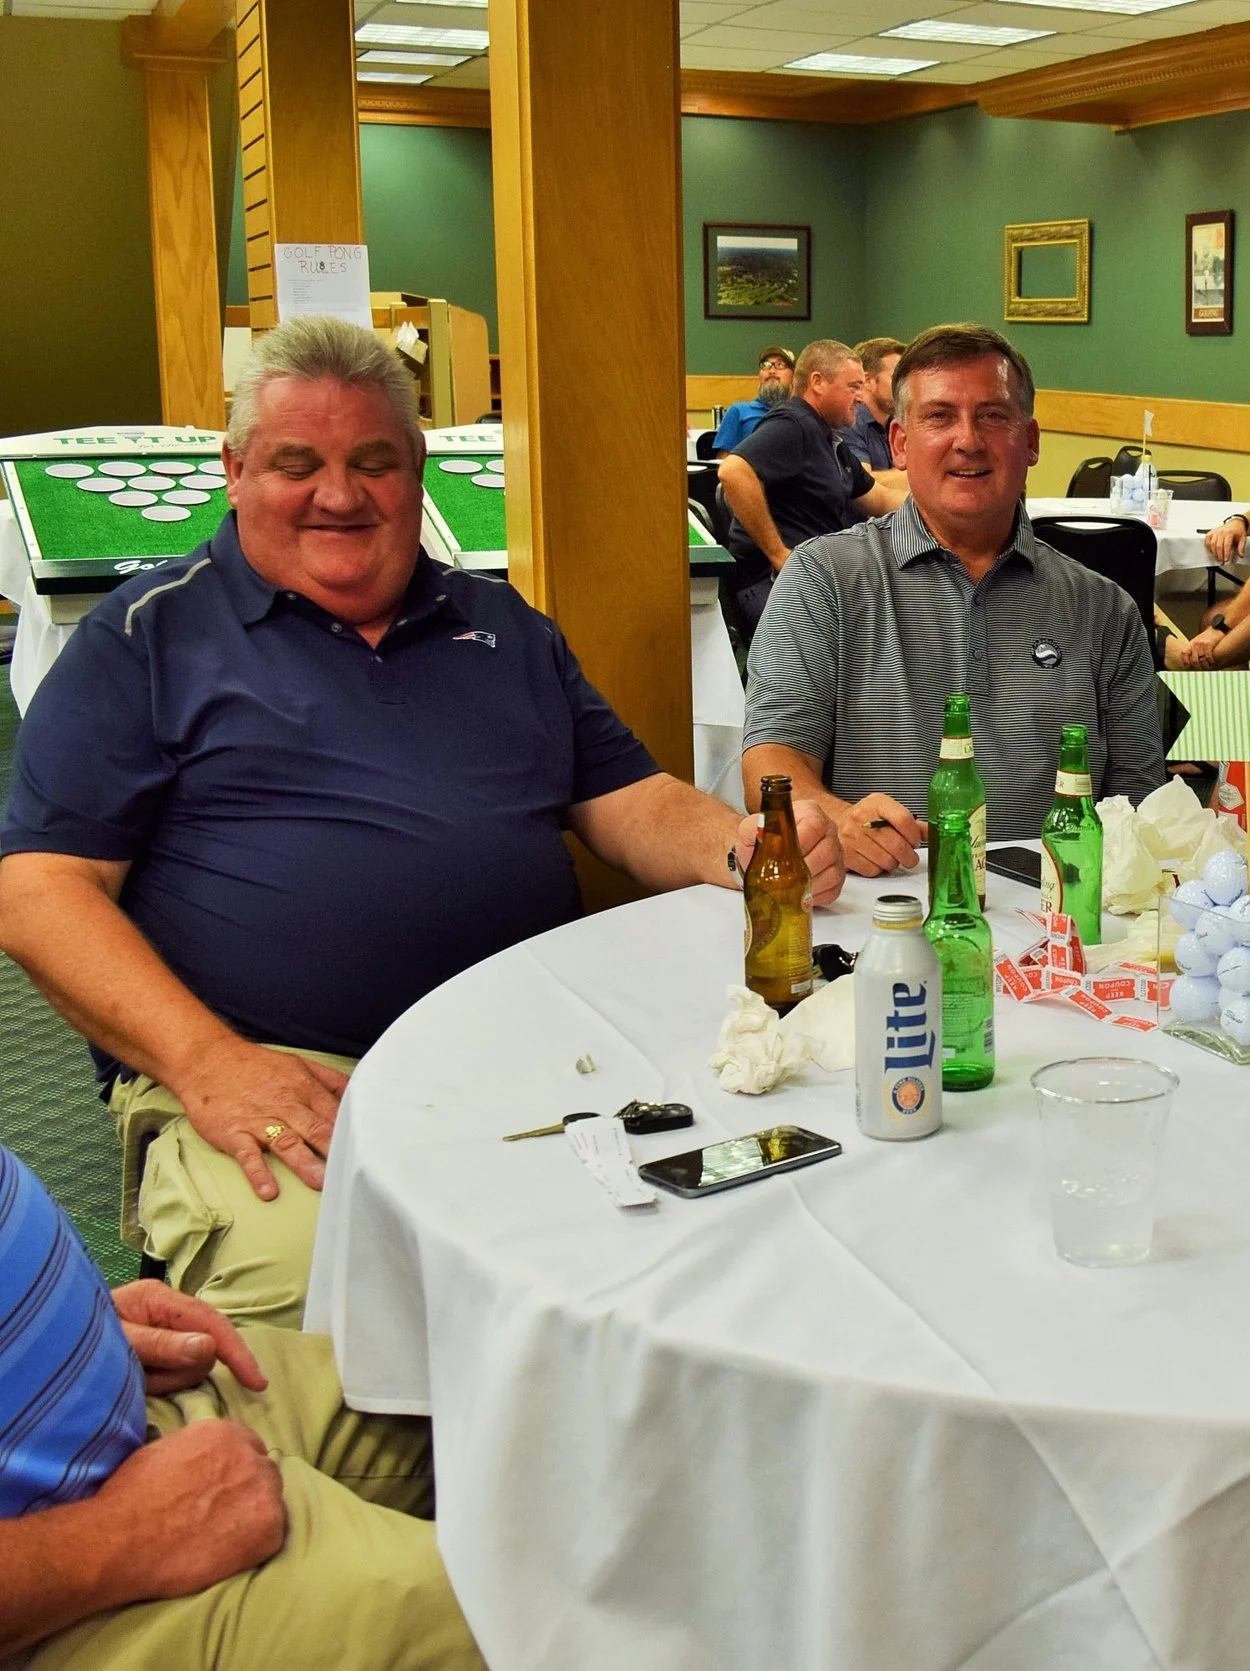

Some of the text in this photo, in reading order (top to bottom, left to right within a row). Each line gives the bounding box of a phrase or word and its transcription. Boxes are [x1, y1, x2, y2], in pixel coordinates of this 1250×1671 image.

[284, 246, 361, 259] GOLF PONG
[175, 436, 217, 444] UP
[1007, 964, 1028, 992] COUPON
[1105, 991, 1124, 999] KEEP
[884, 982, 936, 1075] Lite
